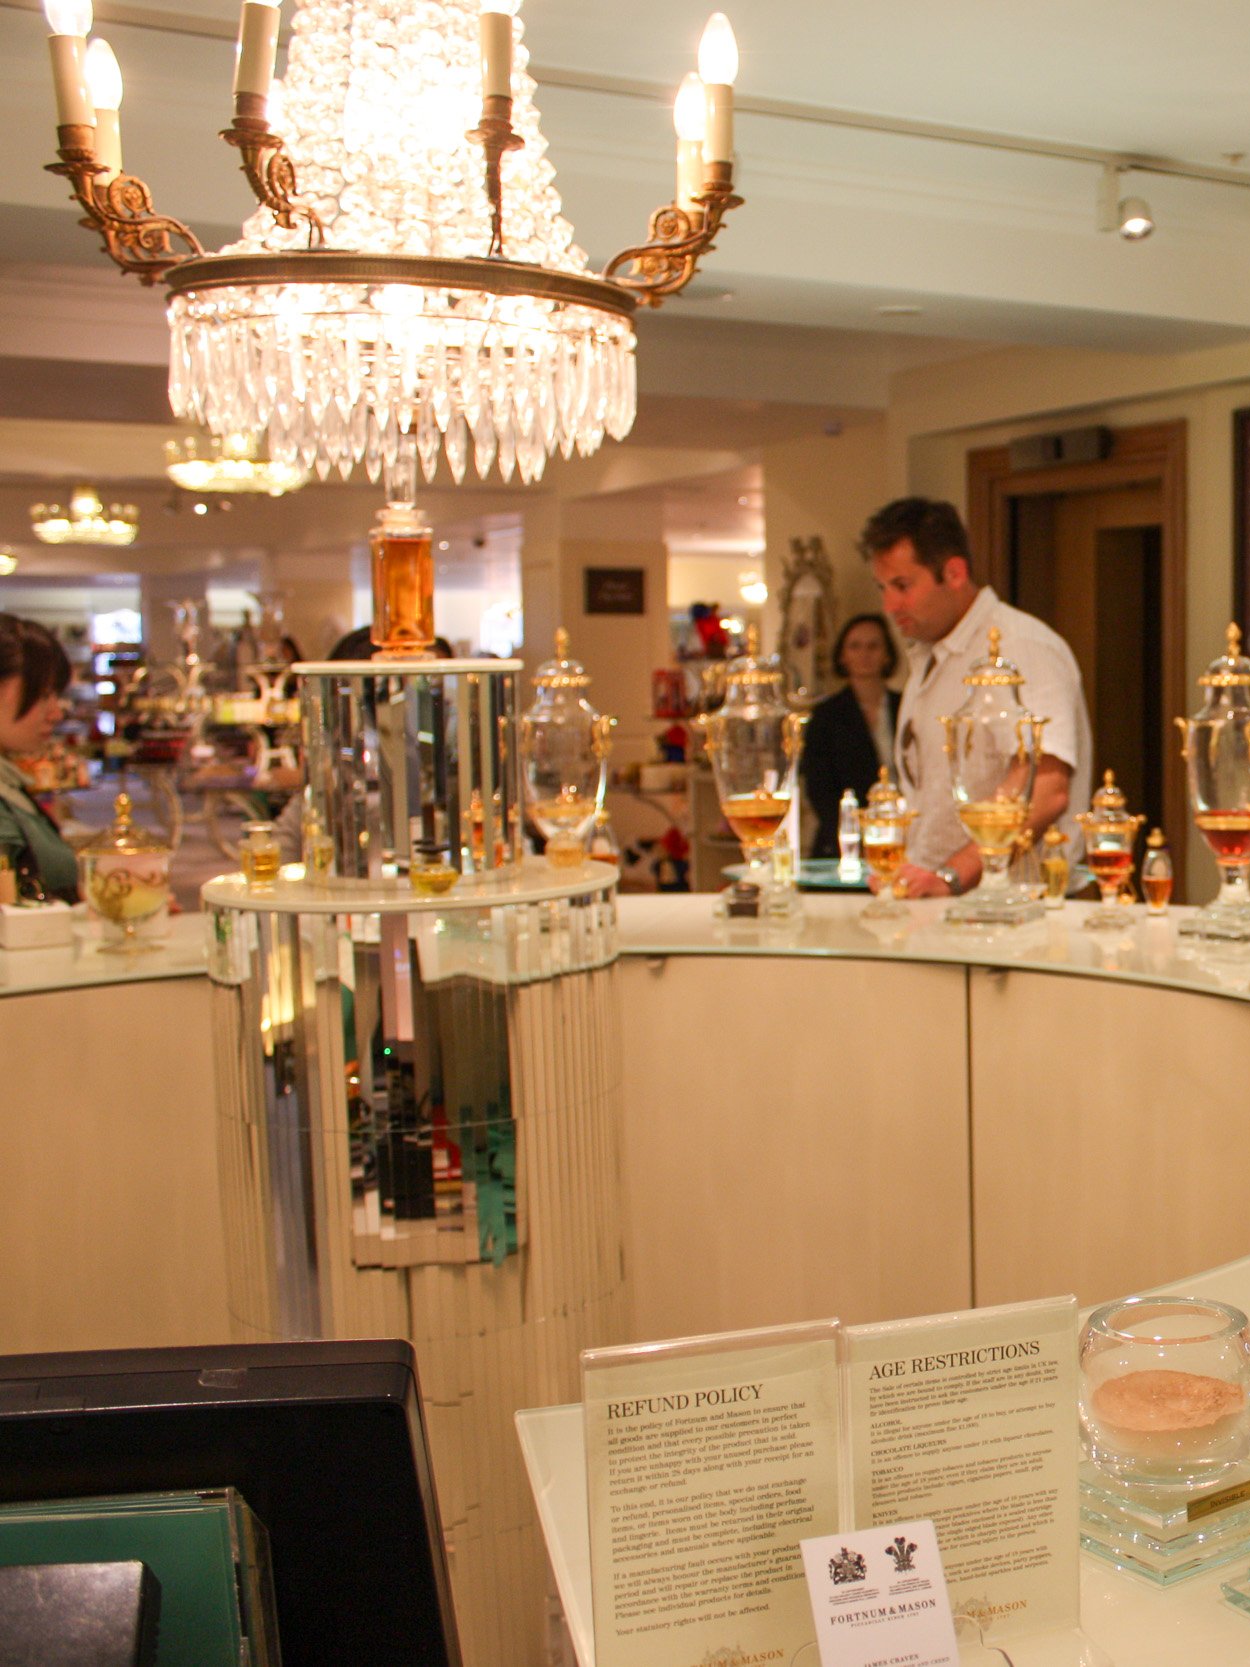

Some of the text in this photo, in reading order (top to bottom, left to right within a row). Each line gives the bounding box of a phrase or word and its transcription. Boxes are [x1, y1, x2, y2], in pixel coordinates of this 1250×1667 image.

[869, 1340, 1040, 1380] AGE RESTRICTIONS
[607, 1383, 764, 1419] REFUND POLICY
[608, 1437, 618, 1445] all
[620, 1434, 642, 1445] goods
[660, 1426, 692, 1438] supplied
[720, 1418, 759, 1429] customers
[771, 1412, 797, 1423] perfect
[640, 1422, 662, 1432] policy
[675, 1416, 707, 1426] Fortnum
[710, 1412, 724, 1421] and
[726, 1410, 750, 1418] Mason
[762, 1405, 788, 1413] ensure
[790, 1401, 805, 1409] that
[870, 1418, 902, 1429] ALCOHOL
[608, 1445, 644, 1455] condition
[647, 1441, 661, 1450] and
[664, 1439, 678, 1447] that
[705, 1431, 735, 1443] possible
[738, 1425, 778, 1438] precaution
[789, 1421, 810, 1429] taken
[619, 1454, 646, 1466] protect
[664, 1447, 695, 1457] integrity
[722, 1439, 751, 1451] product
[754, 1436, 768, 1444] that
[870, 1438, 947, 1456] CHOCOLATE LIQUEURS
[609, 1477, 634, 1486] return
[645, 1471, 668, 1480] within
[682, 1467, 700, 1475] days
[726, 1459, 742, 1468] with
[744, 1458, 761, 1467] your
[764, 1453, 789, 1462] receipt
[618, 1467, 631, 1476] you
[649, 1460, 682, 1469] unhappy
[685, 1455, 701, 1464] with
[704, 1454, 720, 1463] your
[723, 1448, 750, 1458] unused
[753, 1444, 786, 1456] purchase
[789, 1440, 814, 1451] please
[871, 1465, 903, 1476] TOBACCO
[622, 1502, 637, 1511] this
[690, 1492, 712, 1502] policy
[715, 1488, 730, 1497] that
[648, 1519, 669, 1527] items
[719, 1507, 736, 1516] body
[739, 1502, 773, 1513] including
[776, 1498, 806, 1509] perfume
[652, 1502, 701, 1518] personalised
[728, 1494, 754, 1506] special
[785, 1487, 801, 1496] food
[1210, 1491, 1246, 1508] INVISIBLE
[612, 1534, 626, 1543] and
[664, 1526, 686, 1534] Items
[689, 1522, 707, 1530] must
[721, 1514, 754, 1526] returned
[765, 1510, 782, 1518] their
[785, 1504, 814, 1516] original
[872, 1508, 897, 1519] KNIVES
[612, 1541, 652, 1555] packaging
[655, 1537, 669, 1546] and
[672, 1534, 690, 1543] must
[742, 1522, 776, 1532] including
[778, 1514, 812, 1526] electrical
[660, 1546, 674, 1555] and
[676, 1541, 708, 1552] manuals
[712, 1538, 734, 1547] where
[688, 1559, 704, 1568] fault
[707, 1556, 732, 1564] occurs
[734, 1551, 750, 1560] with
[753, 1550, 769, 1559] your
[772, 1543, 799, 1556] product
[830, 1608, 887, 1625] FORTNUM
[889, 1606, 896, 1615] &
[898, 1599, 936, 1613] MASON
[988, 1600, 1027, 1614] MASON
[636, 1621, 670, 1632] statutory
[673, 1616, 695, 1627] rights
[698, 1613, 711, 1622] will
[713, 1611, 725, 1619] not
[741, 1648, 784, 1664] MASON
[865, 1658, 888, 1667] JAMES
